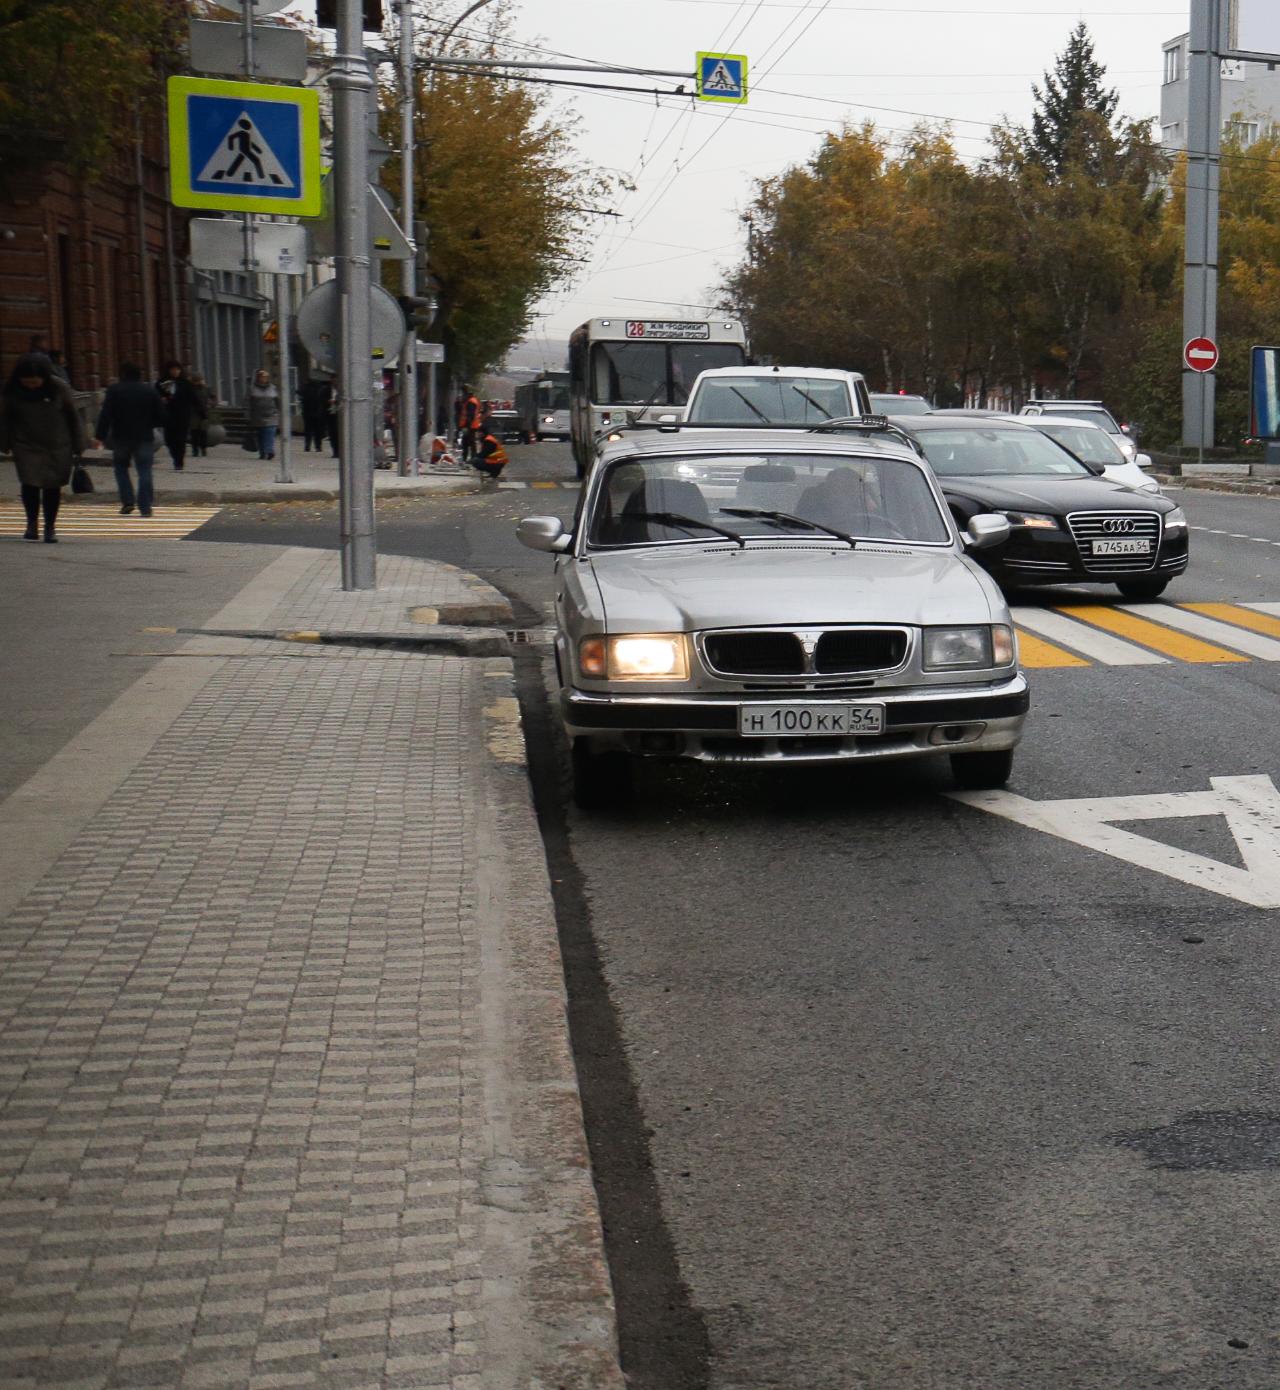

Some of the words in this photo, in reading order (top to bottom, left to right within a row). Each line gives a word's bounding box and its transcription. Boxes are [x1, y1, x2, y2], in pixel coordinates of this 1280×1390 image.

[629, 322, 644, 336] 28
[1097, 542, 1135, 553] А745АА
[1136, 541, 1147, 550] 54
[852, 708, 874, 724] 54
